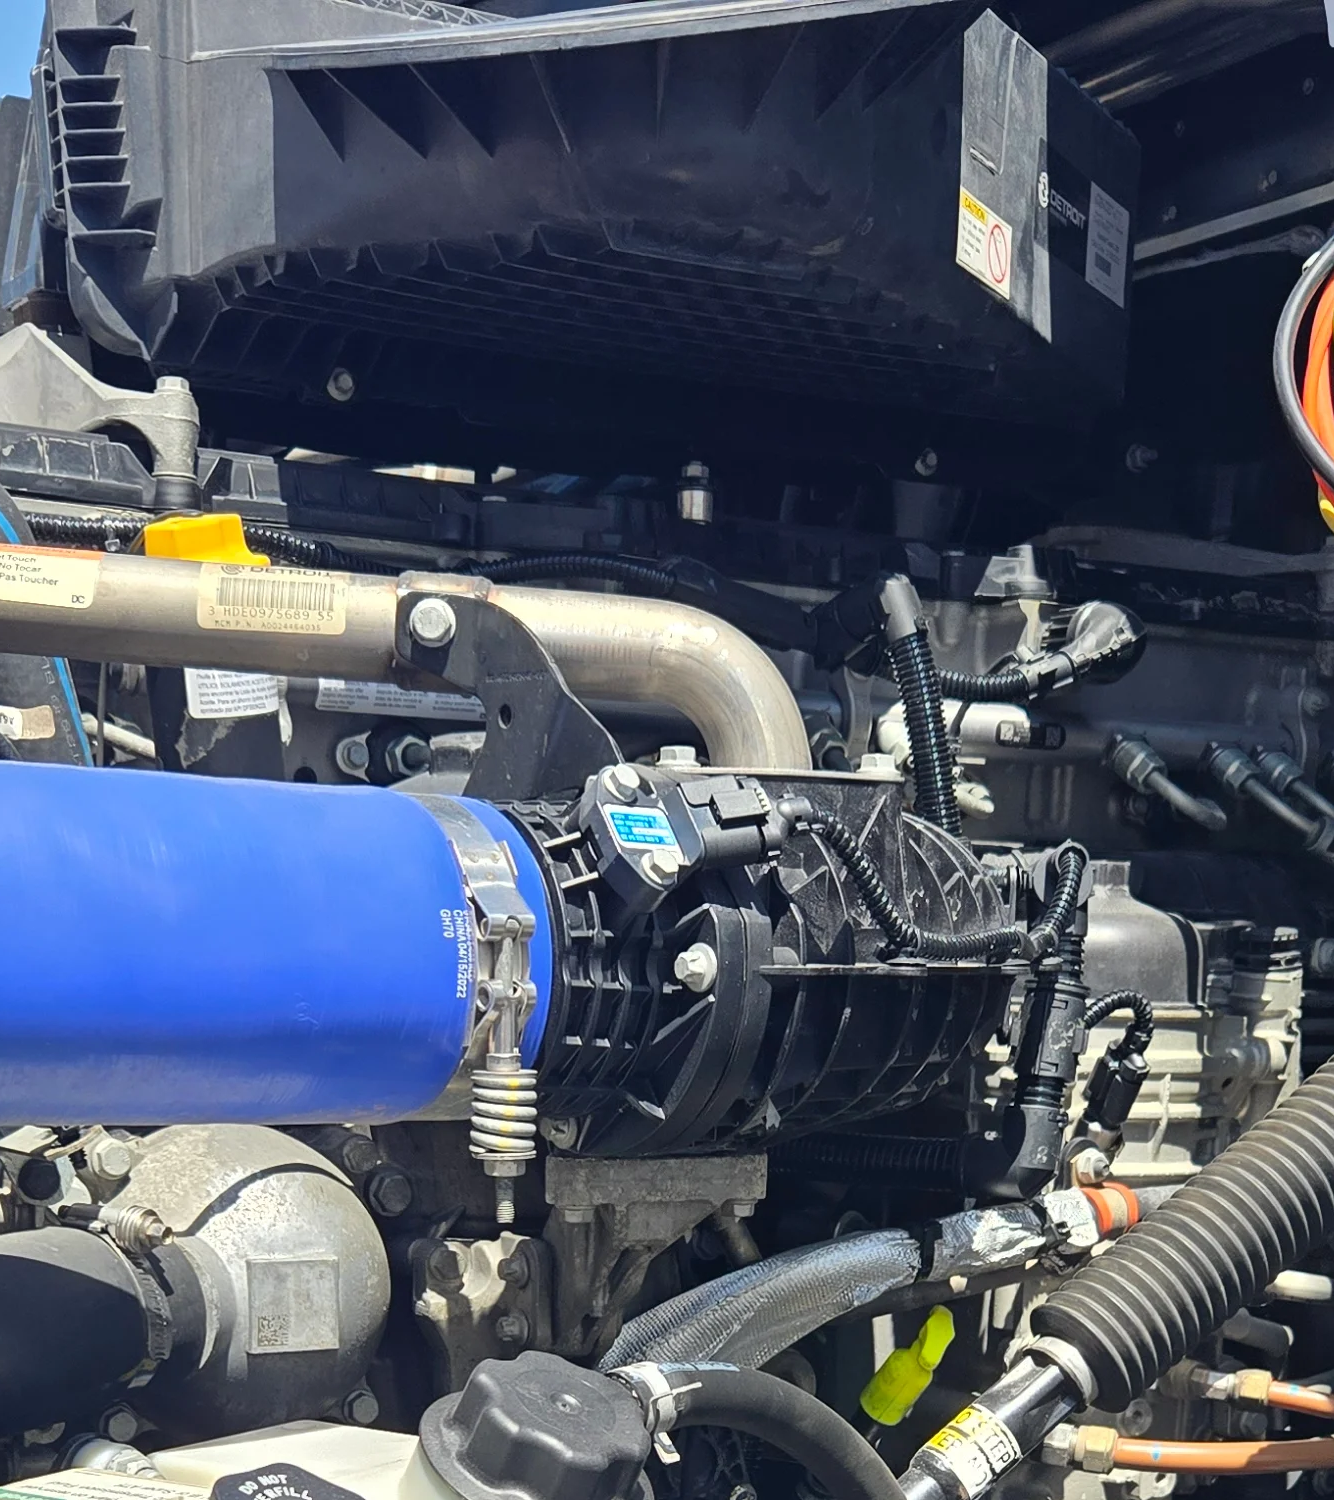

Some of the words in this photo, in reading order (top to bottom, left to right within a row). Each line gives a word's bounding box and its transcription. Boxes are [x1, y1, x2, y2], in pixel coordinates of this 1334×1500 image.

[1050, 188, 1086, 230] DETROIT
[8, 554, 37, 563] Touch
[16, 564, 43, 573] Tocar
[19, 574, 59, 586] Toucher
[71, 595, 85, 604] DC
[208, 606, 216, 616] 3
[439, 909, 455, 938] GH70
[453, 910, 464, 941] CHINA
[238, 1481, 259, 1495] DO
[257, 1474, 287, 1486] NOT
